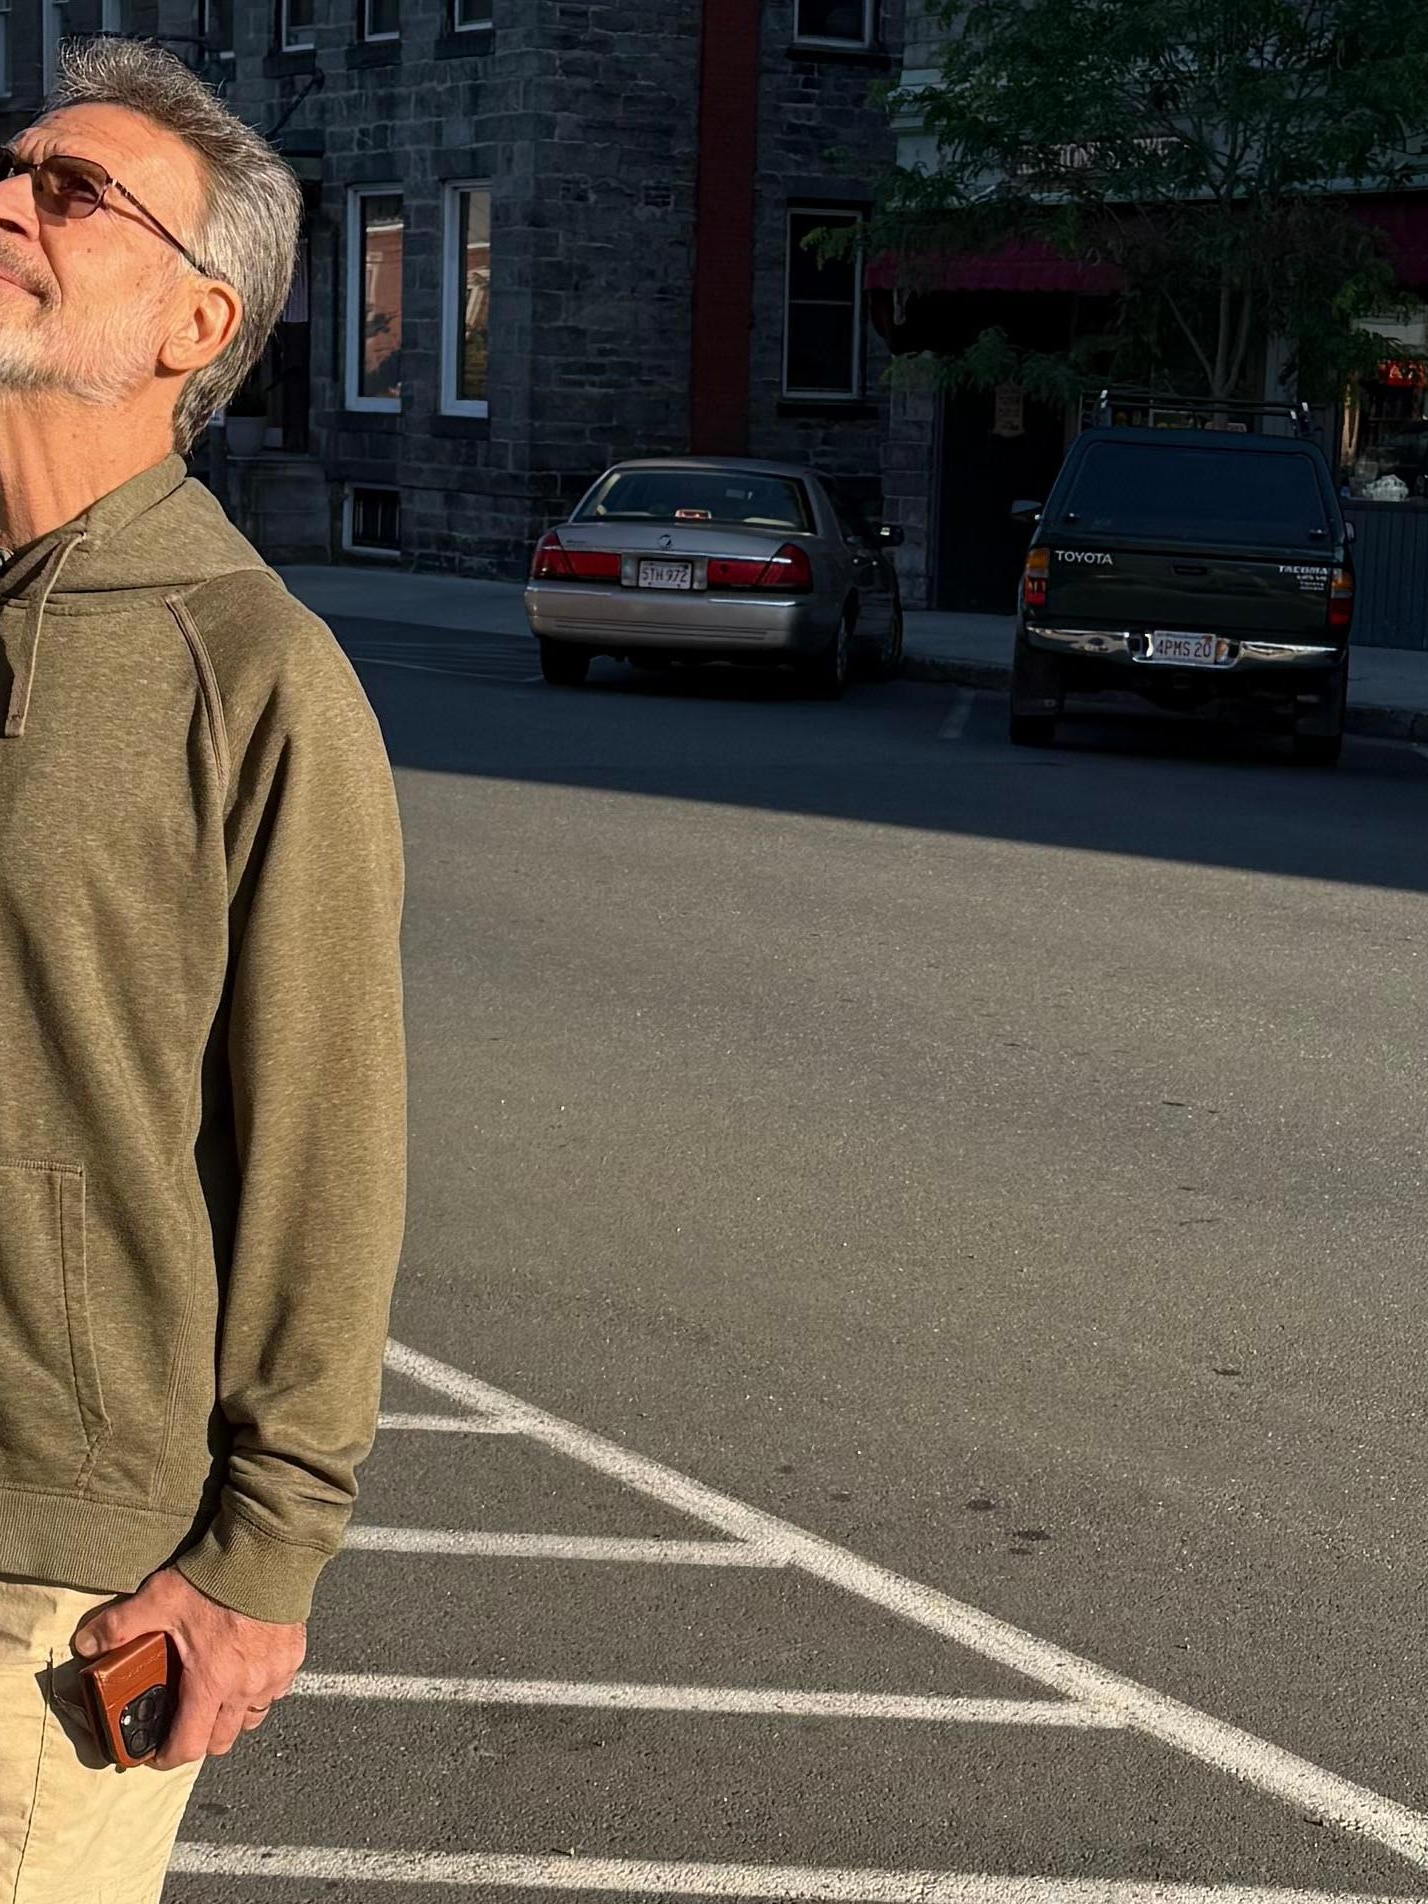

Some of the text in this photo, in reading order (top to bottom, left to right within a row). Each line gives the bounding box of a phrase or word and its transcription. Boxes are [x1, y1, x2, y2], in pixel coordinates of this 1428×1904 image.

[1055, 549, 1114, 565] TOYOTA
[1277, 564, 1328, 575] TACOMA
[1194, 640, 1212, 658] 20
